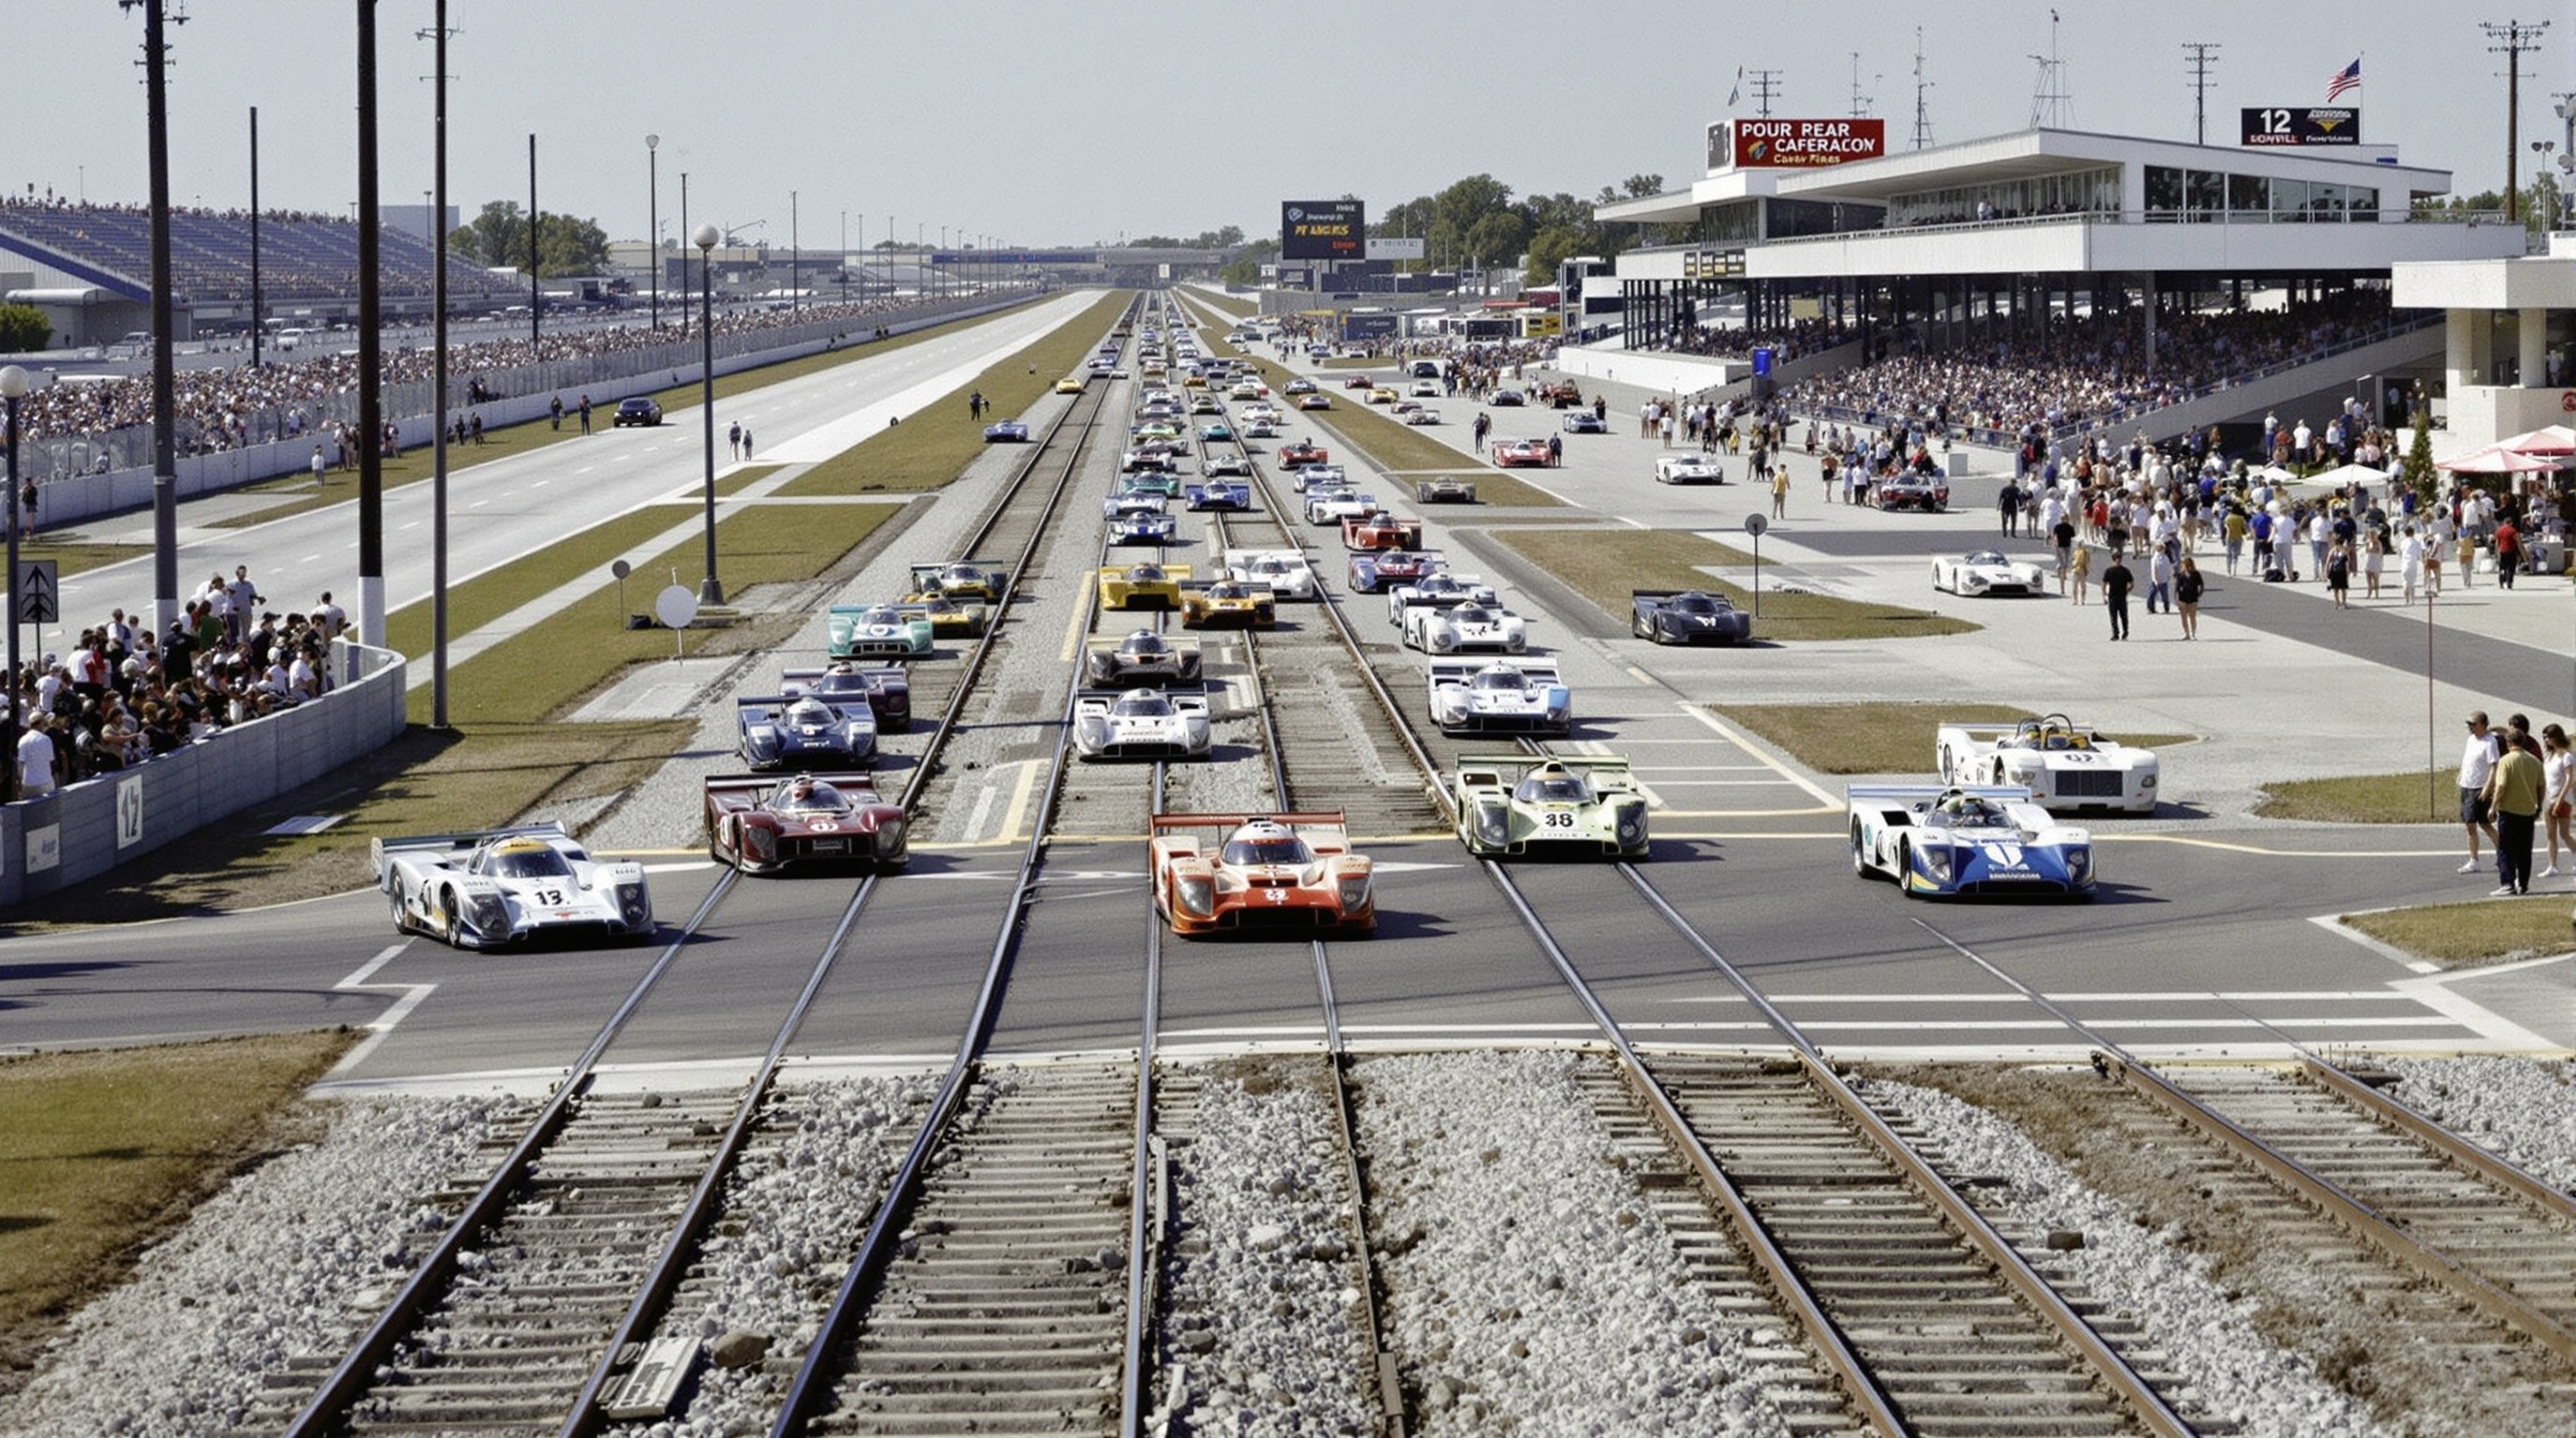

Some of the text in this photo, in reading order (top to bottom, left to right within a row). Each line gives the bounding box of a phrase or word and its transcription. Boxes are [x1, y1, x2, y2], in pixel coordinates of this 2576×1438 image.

[2260, 110, 2291, 133] 12
[1741, 123, 1851, 138] POUR REAR
[1775, 138, 1875, 153] CAFERACON
[1544, 813, 1574, 829] 38
[534, 889, 564, 906] 13
